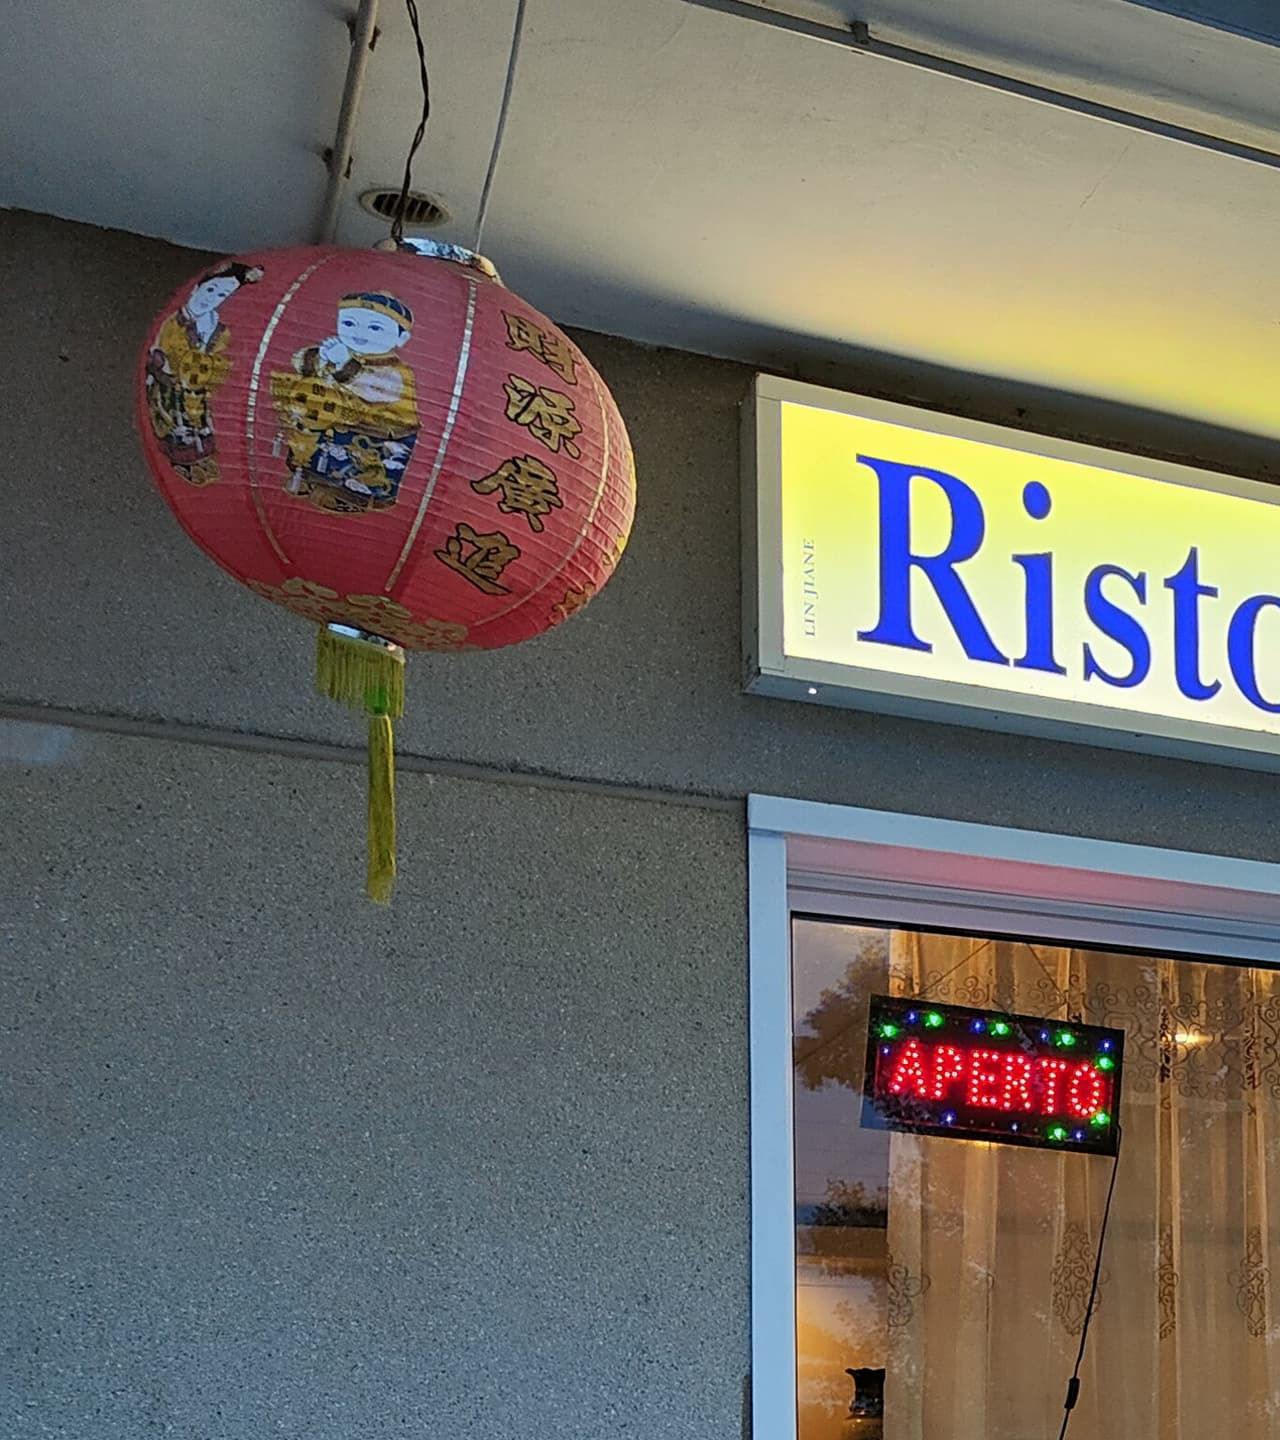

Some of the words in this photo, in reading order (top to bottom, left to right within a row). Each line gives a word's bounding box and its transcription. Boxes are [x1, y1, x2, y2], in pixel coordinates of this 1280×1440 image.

[803, 539, 818, 599] JIANE
[804, 602, 815, 636] LIN
[889, 1038, 1104, 1118] APERTO
